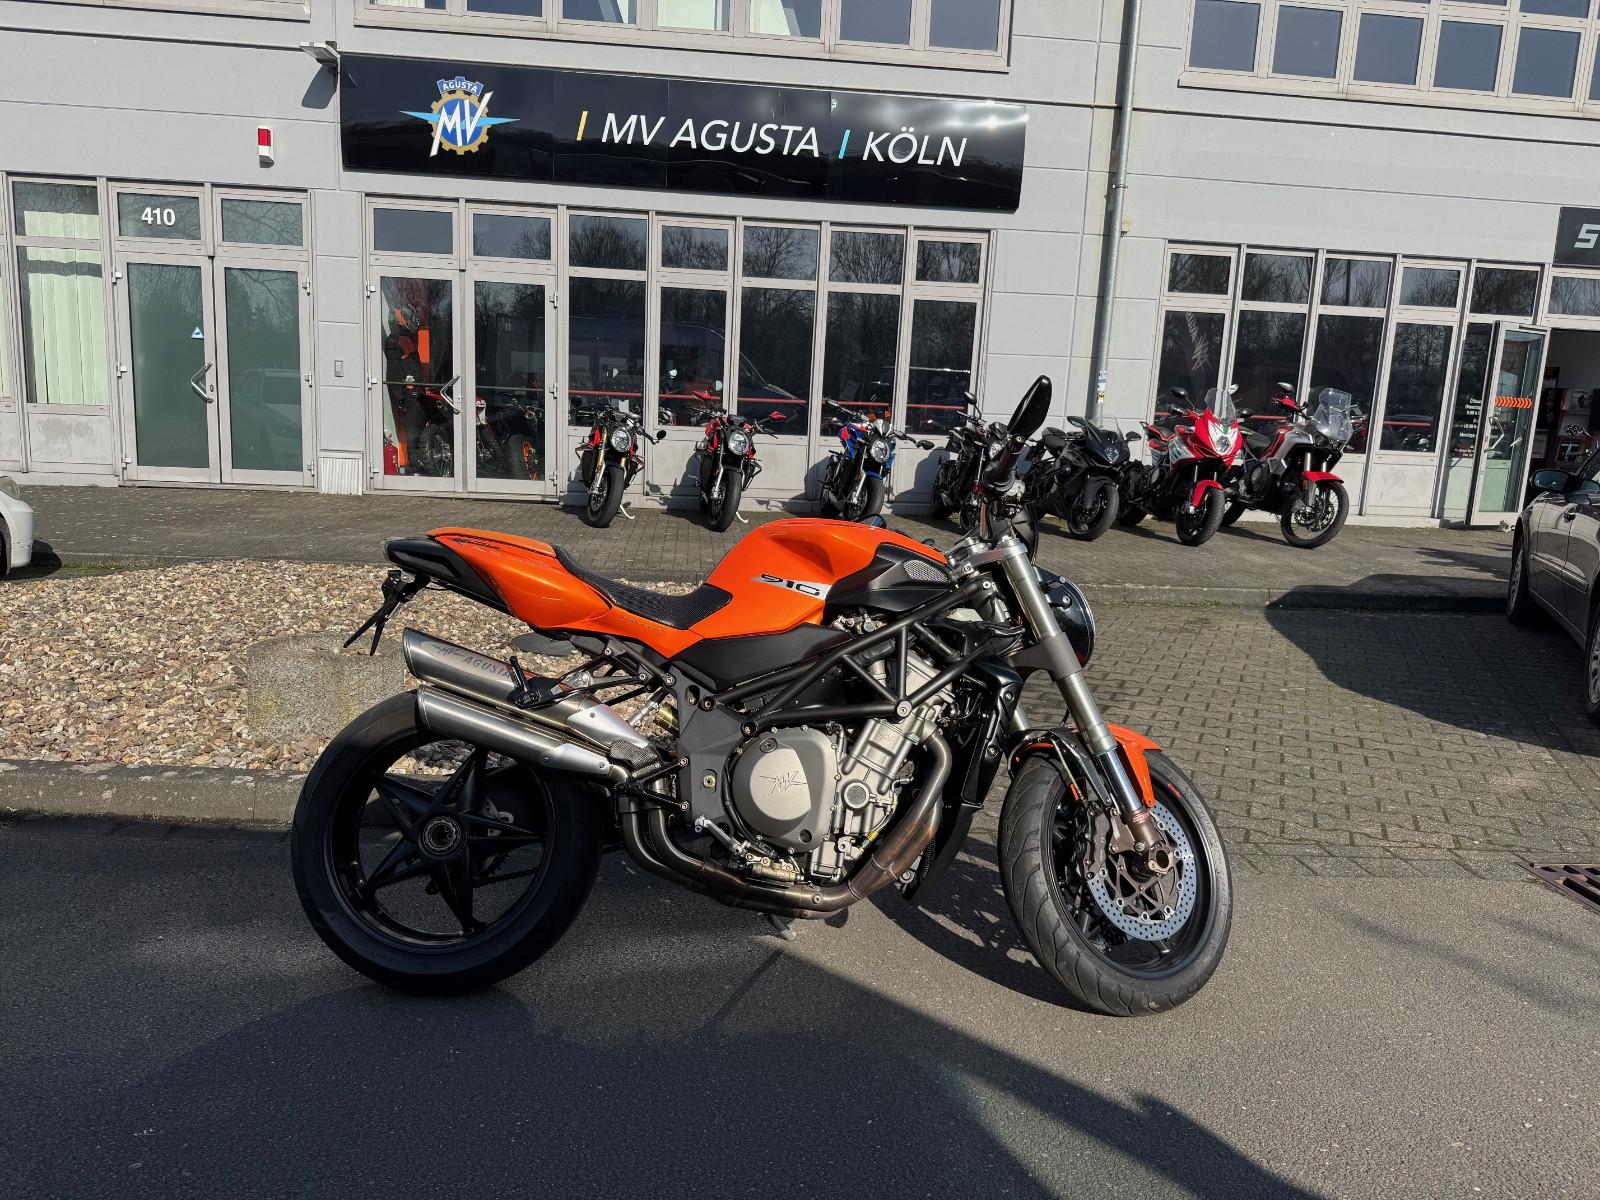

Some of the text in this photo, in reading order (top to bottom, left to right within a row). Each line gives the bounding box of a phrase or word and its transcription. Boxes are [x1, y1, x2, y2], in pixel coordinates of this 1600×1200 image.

[442, 81, 479, 93] AGUSTA
[429, 91, 494, 158] MV
[601, 112, 968, 167] MV AGUSTA KÖLN
[141, 206, 176, 226] 410
[760, 573, 821, 596] 910
[463, 656, 511, 679] AGUSTA
